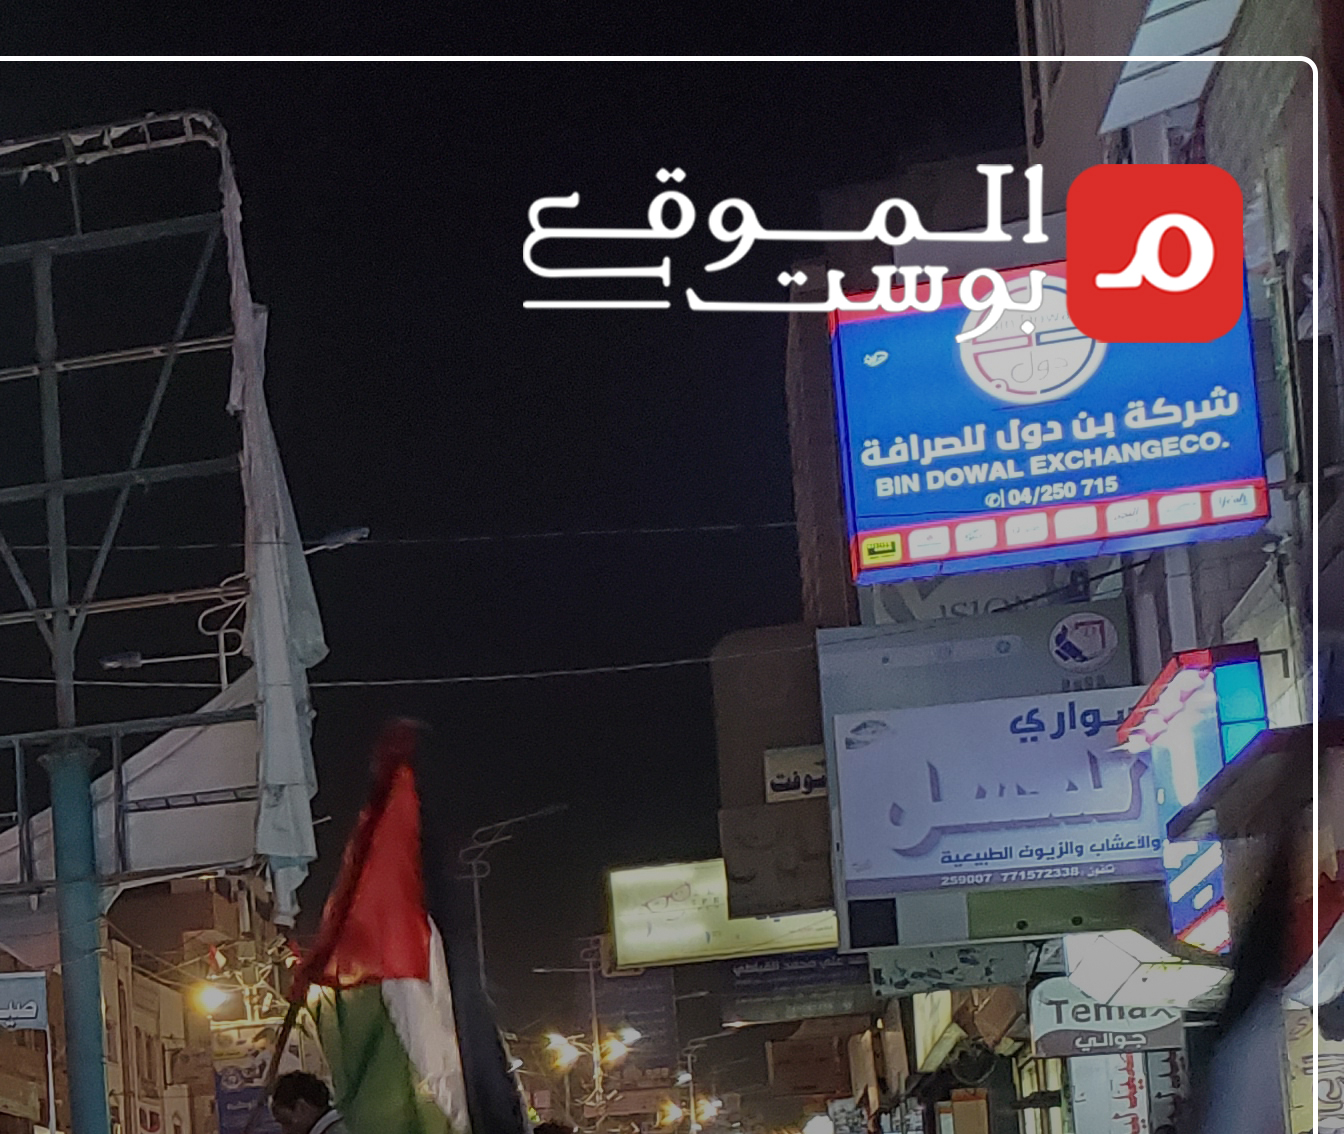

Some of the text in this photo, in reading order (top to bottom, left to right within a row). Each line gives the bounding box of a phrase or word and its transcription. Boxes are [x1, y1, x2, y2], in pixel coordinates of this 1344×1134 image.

[860, 386, 1239, 468] شركة بن دول للصرافة
[875, 474, 920, 498] BIN
[925, 458, 1024, 491] DOWAL
[1006, 476, 1119, 508] 04/250 715
[940, 846, 1013, 868] الطبيعية
[1074, 1031, 1147, 1053] جوالي
